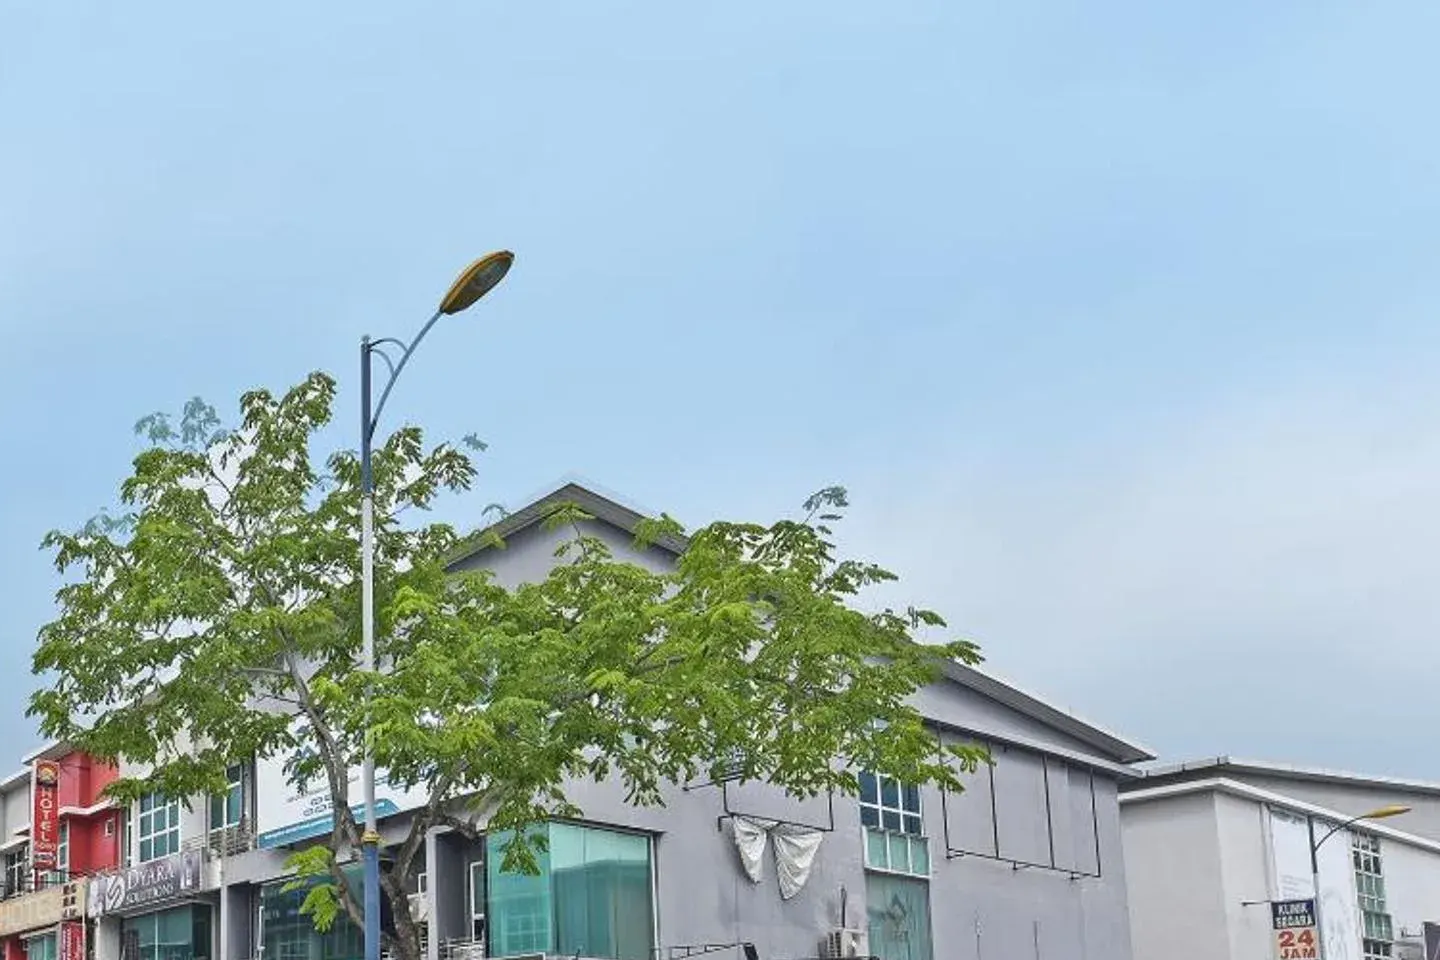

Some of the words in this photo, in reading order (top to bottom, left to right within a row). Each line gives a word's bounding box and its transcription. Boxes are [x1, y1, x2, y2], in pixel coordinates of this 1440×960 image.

[40, 786, 53, 842] HOTEL
[1278, 929, 1314, 947] 24
[1280, 947, 1316, 960] JAM
